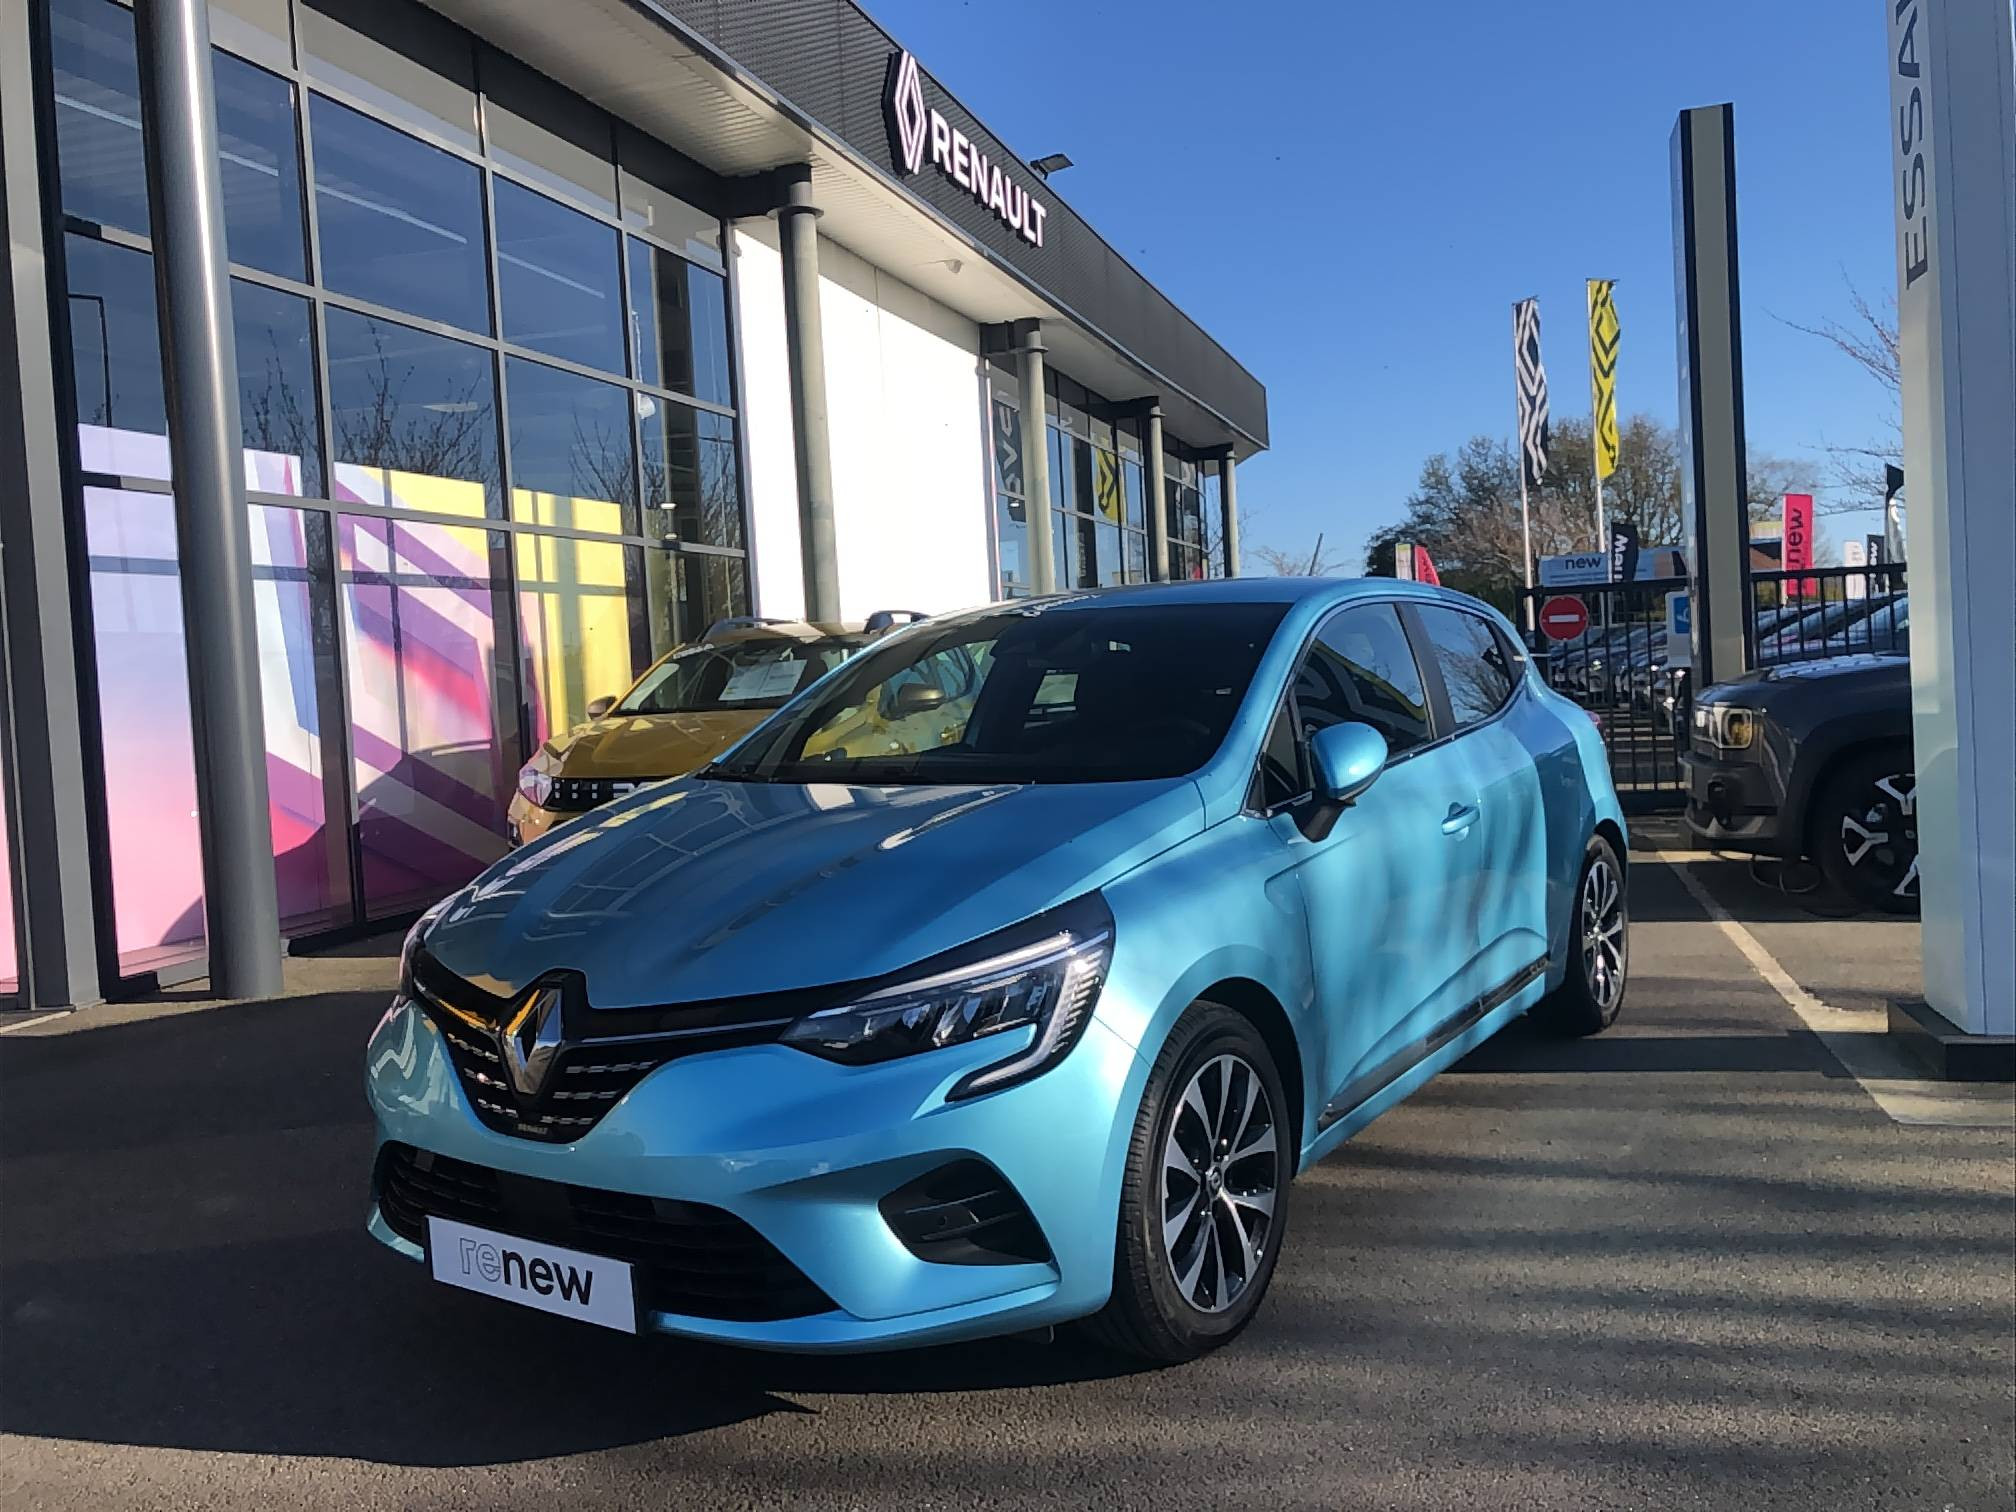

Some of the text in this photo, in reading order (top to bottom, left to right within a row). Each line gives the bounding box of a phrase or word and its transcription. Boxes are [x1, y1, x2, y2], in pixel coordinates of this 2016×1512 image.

[931, 108, 1047, 248] RENAULT
[1787, 507, 1804, 564] new
[459, 1237, 593, 1306] renew
